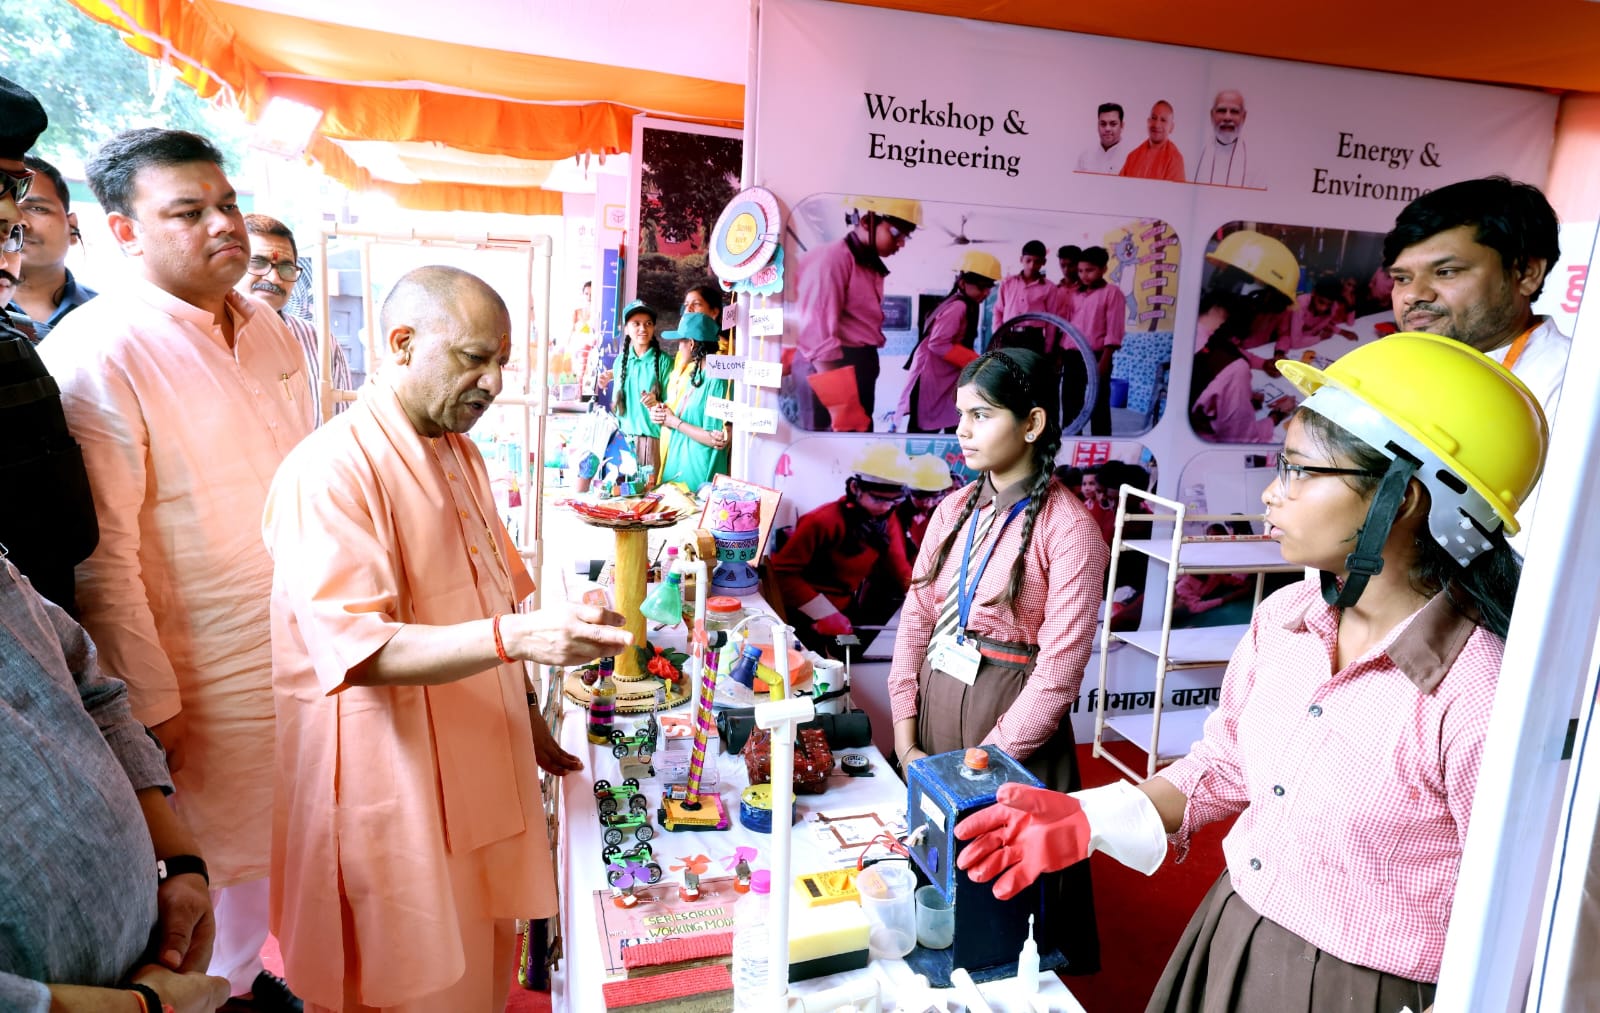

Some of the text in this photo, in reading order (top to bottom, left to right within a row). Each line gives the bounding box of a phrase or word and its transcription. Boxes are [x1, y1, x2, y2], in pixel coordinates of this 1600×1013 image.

[864, 93, 1029, 136] Workshop &
[868, 133, 1021, 177] Engineering
[1337, 132, 1441, 169] Energy &
[1312, 168, 1431, 202] Environm
[708, 360, 745, 370] WELCOME
[649, 917, 735, 938] WORKING MOD
